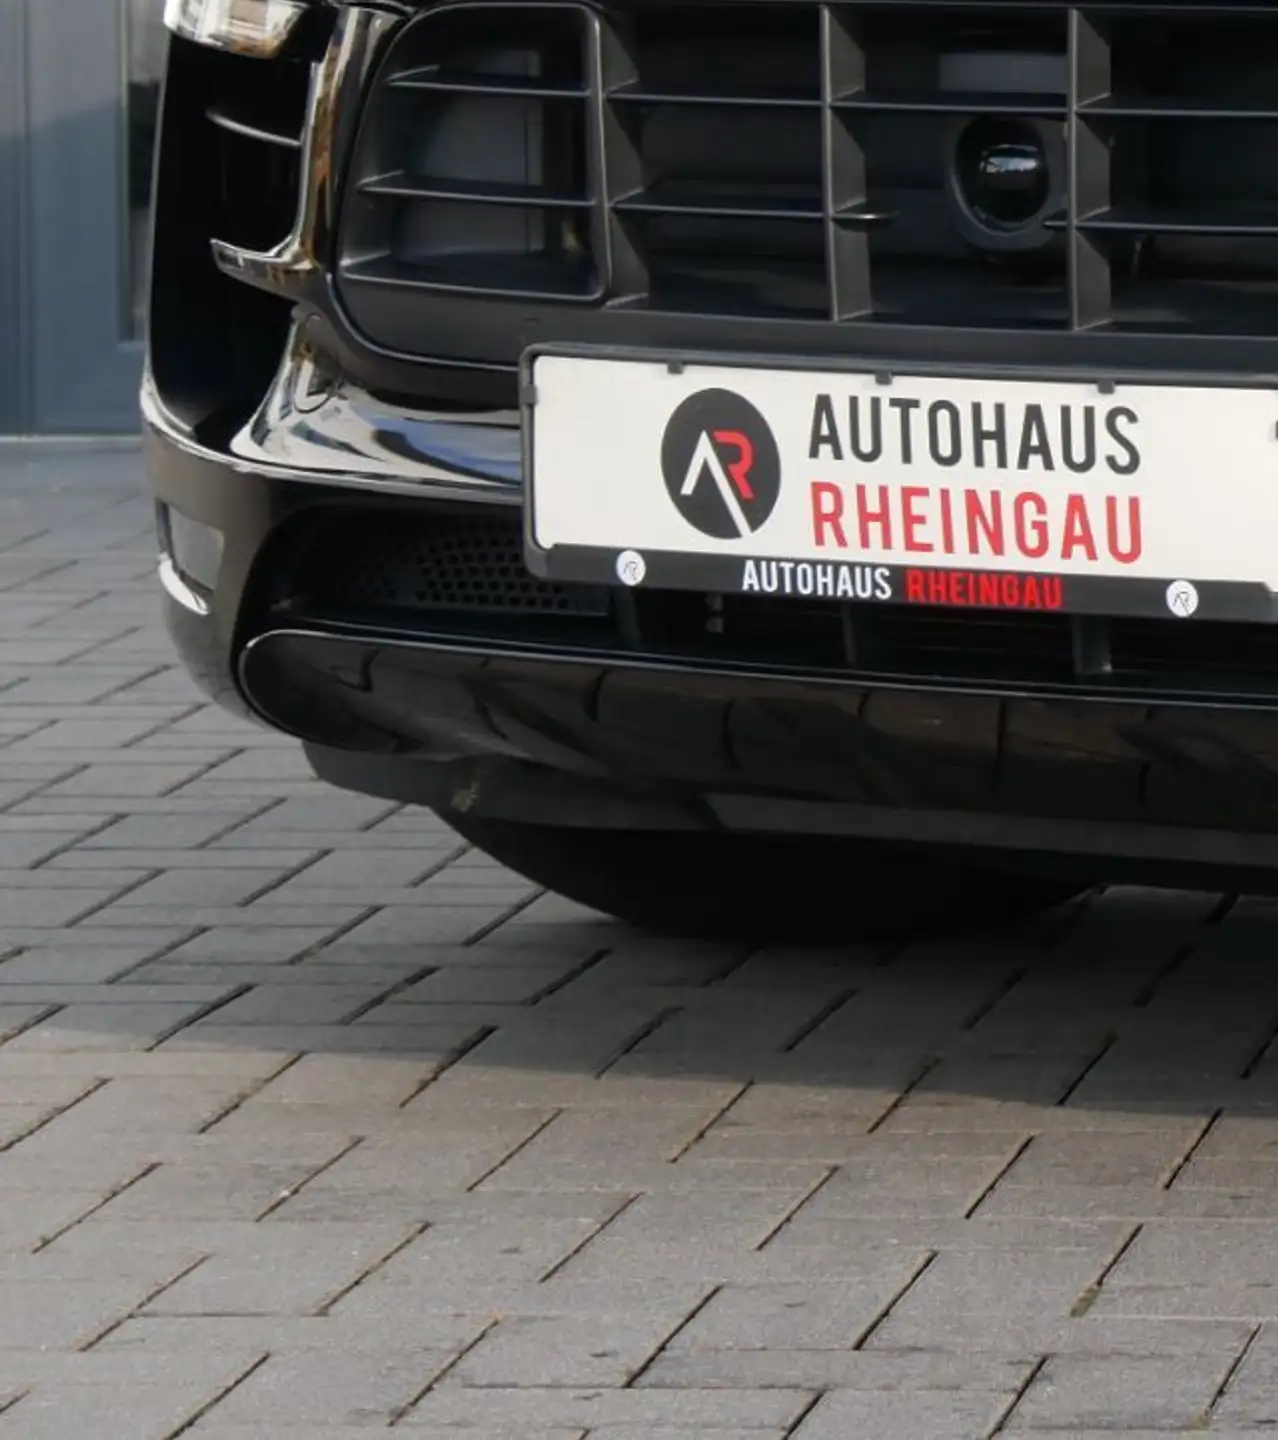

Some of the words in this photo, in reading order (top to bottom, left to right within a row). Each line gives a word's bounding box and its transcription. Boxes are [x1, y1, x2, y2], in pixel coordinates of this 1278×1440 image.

[808, 393, 1140, 475] AUTOHAUS
[810, 481, 1142, 565] RHEINGAU
[741, 559, 893, 601] AUTOHAUS
[904, 568, 1064, 611] RHEINGAU
